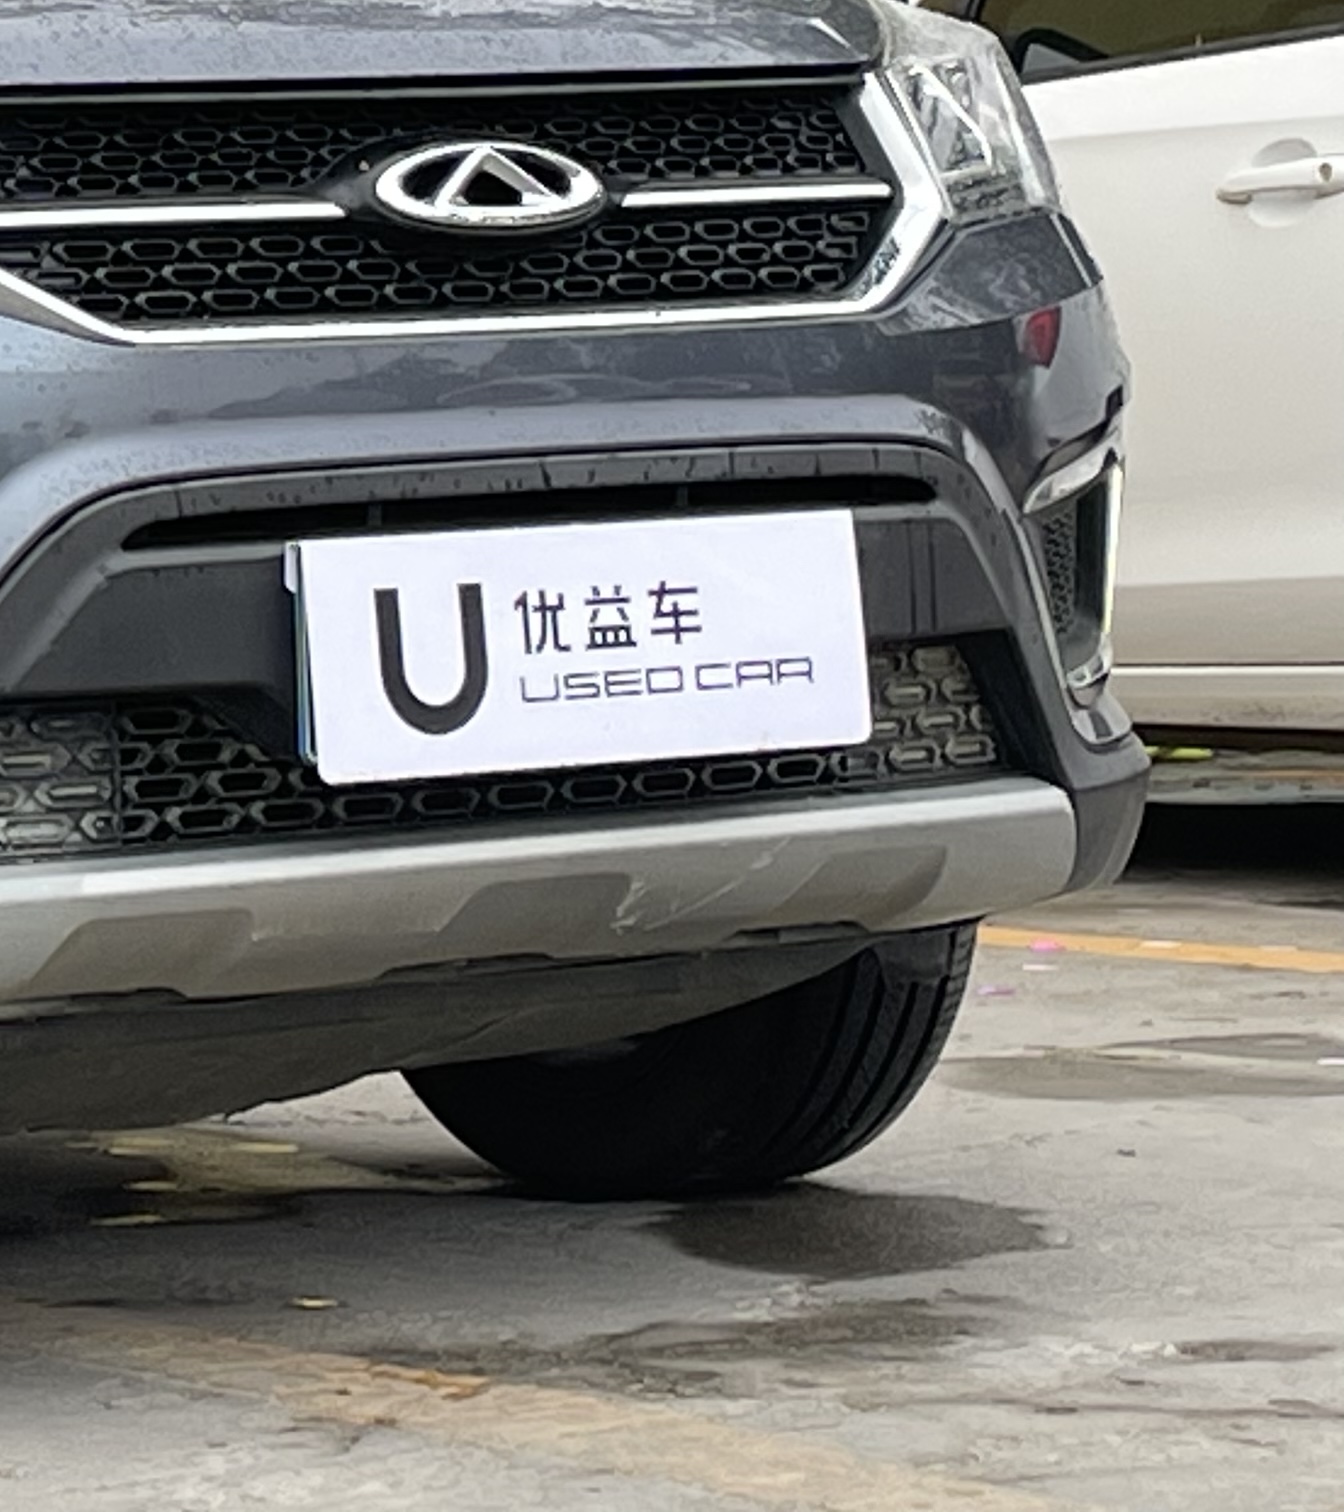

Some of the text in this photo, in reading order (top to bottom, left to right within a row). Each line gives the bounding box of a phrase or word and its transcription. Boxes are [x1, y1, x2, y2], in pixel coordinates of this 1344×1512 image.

[513, 580, 703, 655] 优益车
[373, 582, 489, 735] U
[519, 656, 814, 703] USED CAR
